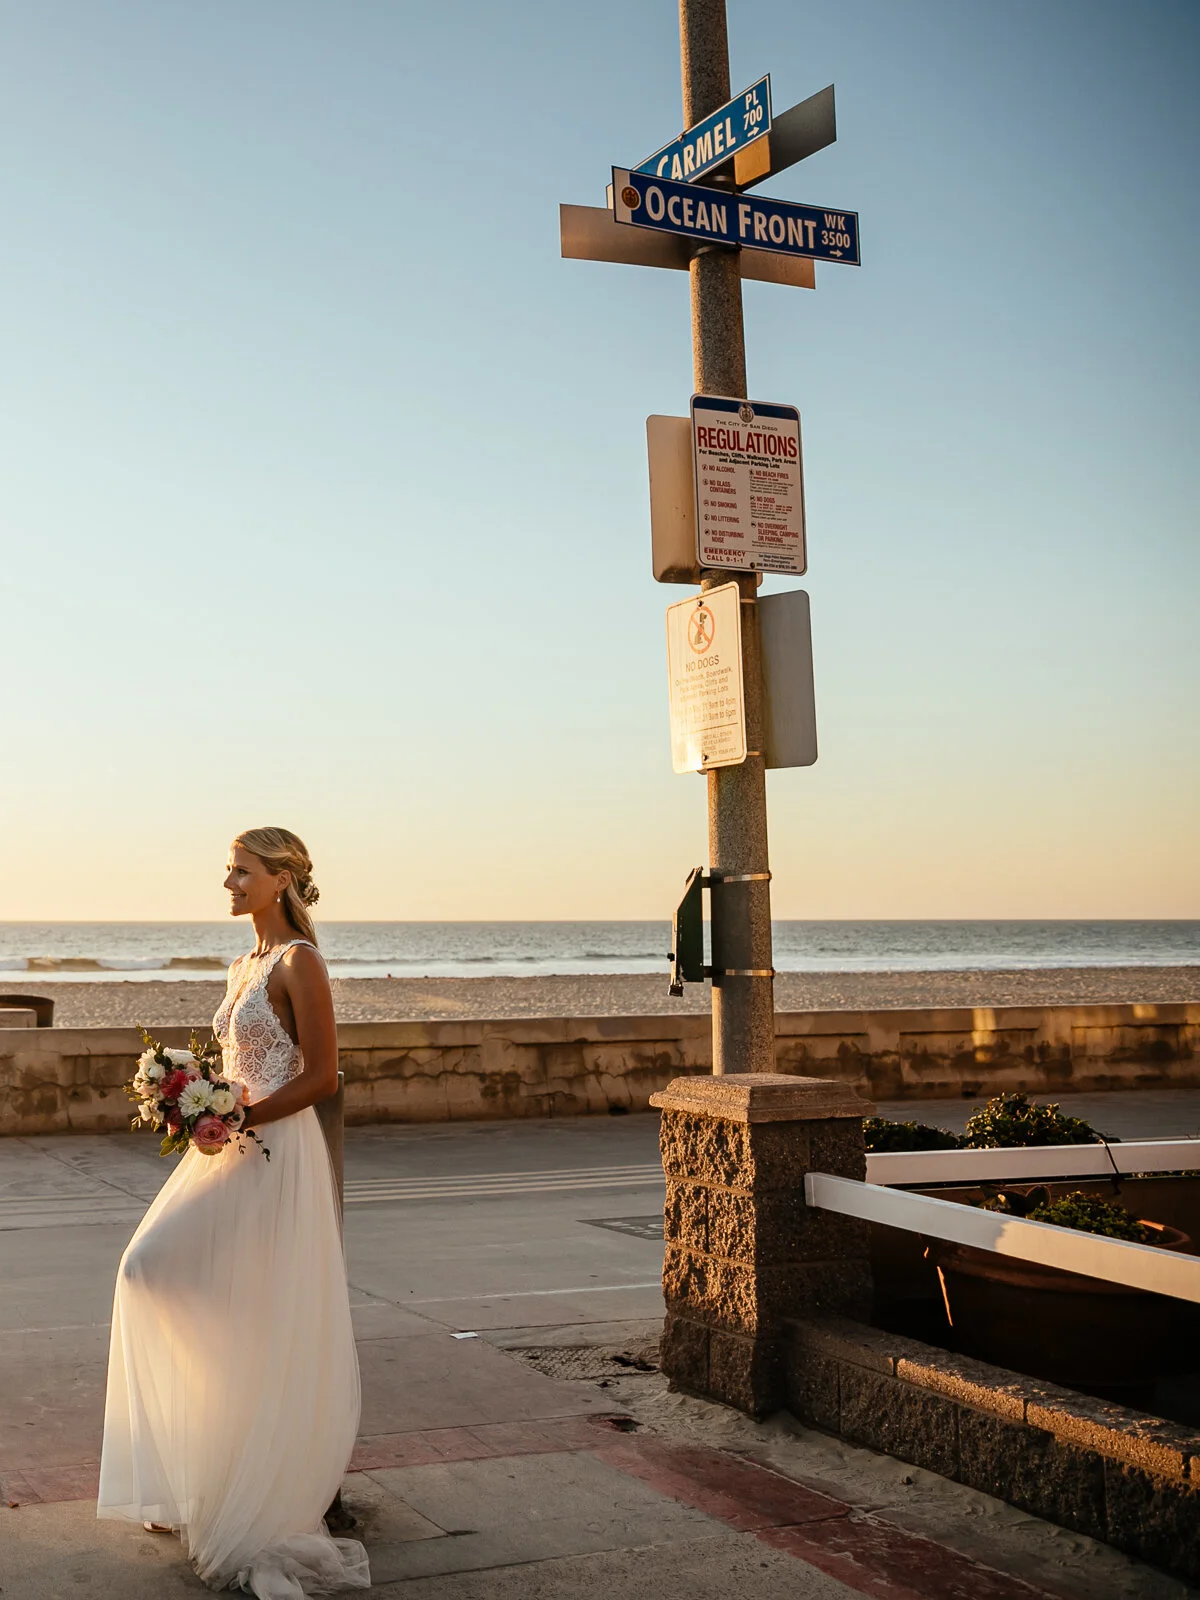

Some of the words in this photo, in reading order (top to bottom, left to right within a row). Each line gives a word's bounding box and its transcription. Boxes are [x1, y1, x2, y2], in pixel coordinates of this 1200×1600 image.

[745, 89, 759, 111] PL
[743, 104, 763, 131] 700
[656, 117, 736, 181] CARMEL
[645, 185, 728, 235] OCEAN
[738, 202, 817, 250] FRONT
[824, 213, 846, 231] WK
[821, 230, 851, 249] 3500
[697, 426, 798, 458] REGULATIONS
[708, 450, 730, 458] Beaches,
[718, 515, 740, 523] LITTERING
[704, 546, 746, 557] EMERGENCY
[686, 661, 696, 672] NO
[698, 654, 719, 670] DOGS
